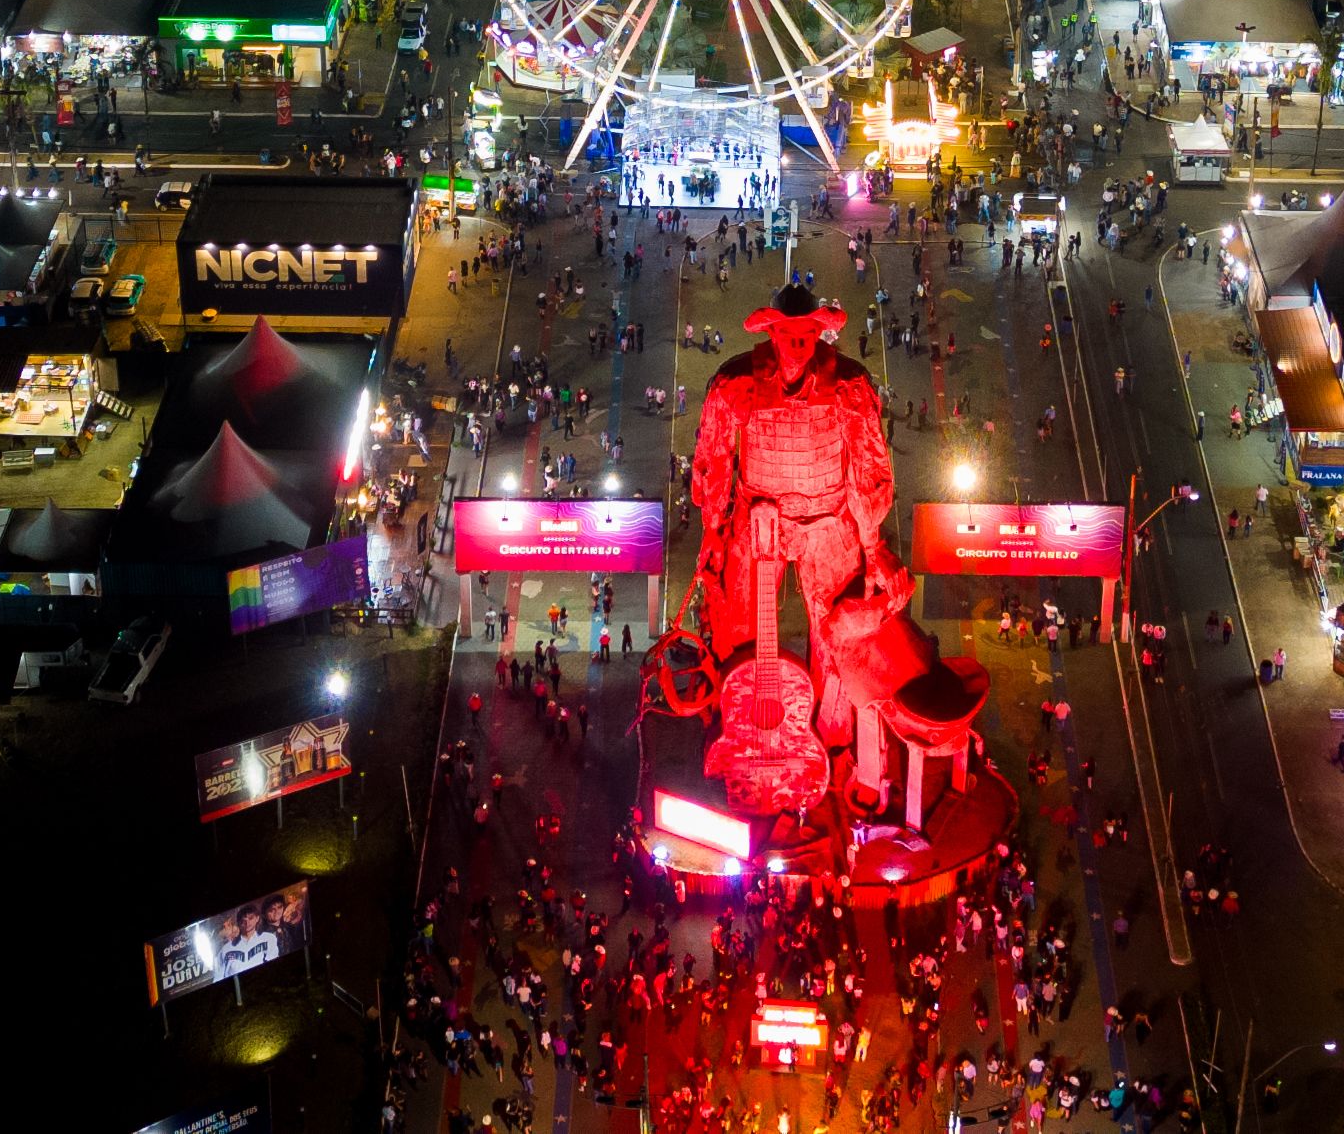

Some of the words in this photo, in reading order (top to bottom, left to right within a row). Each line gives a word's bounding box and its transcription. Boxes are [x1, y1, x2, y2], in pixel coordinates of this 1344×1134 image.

[195, 249, 378, 284] NICNET
[242, 282, 267, 290] essa
[204, 768, 243, 788] BARRET
[206, 778, 244, 801] 202
